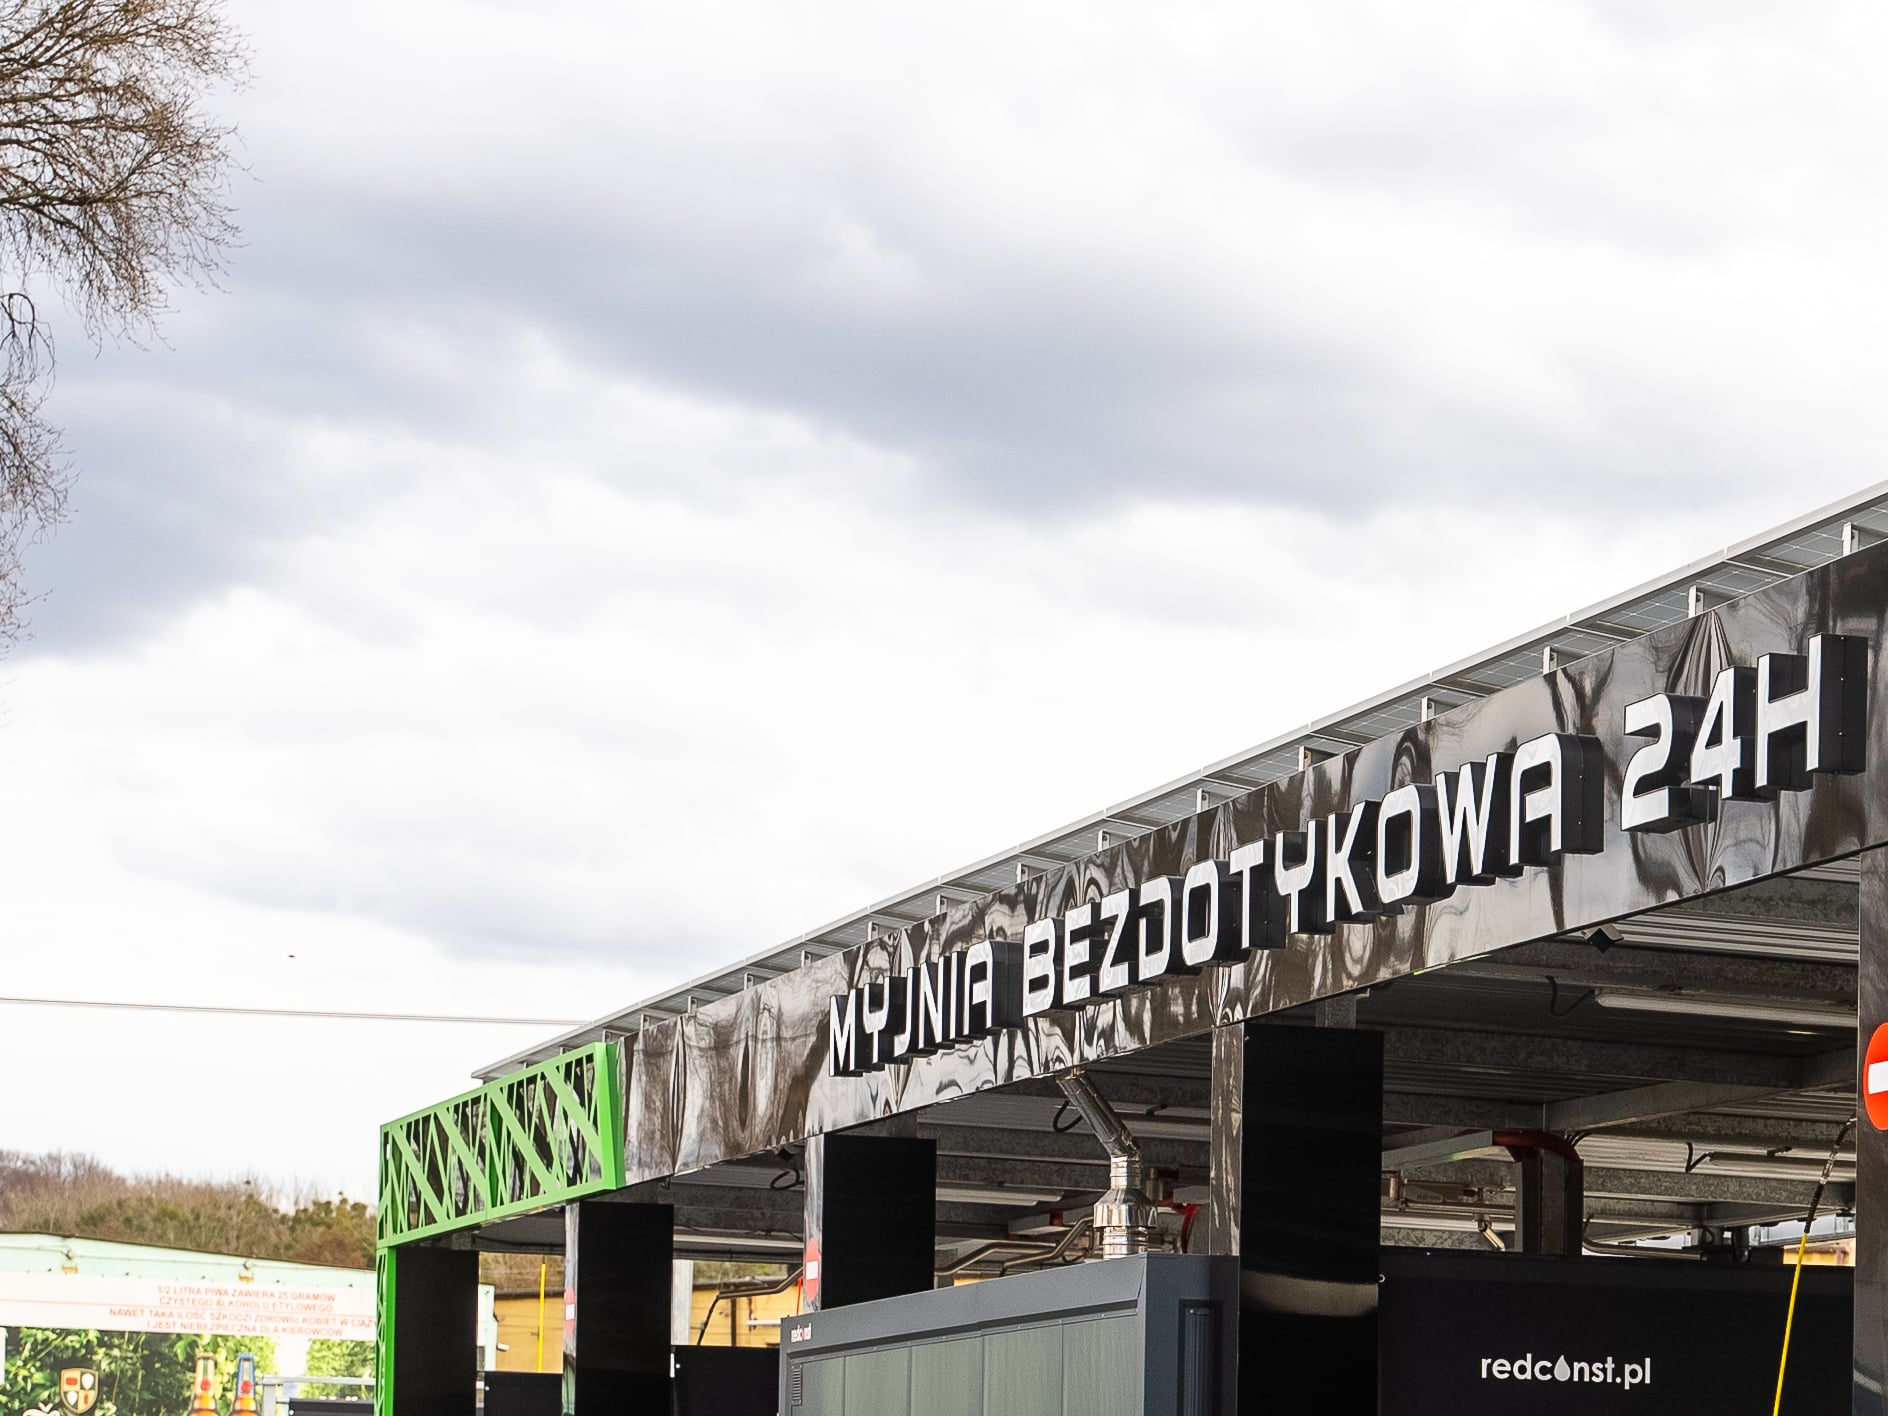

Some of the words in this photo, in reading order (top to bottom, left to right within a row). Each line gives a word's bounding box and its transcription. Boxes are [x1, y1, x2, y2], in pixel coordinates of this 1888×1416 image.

[829, 940, 994, 1078] MYJNIA
[1022, 732, 1565, 1017] BEZDOTYKOWA
[1620, 634, 1823, 834] 24H
[174, 1286, 202, 1296] LITRA
[205, 1287, 230, 1297] PIWA
[232, 1288, 276, 1299] ZAWIERA
[109, 1307, 144, 1317] NAWET
[149, 1309, 176, 1319] TAKA
